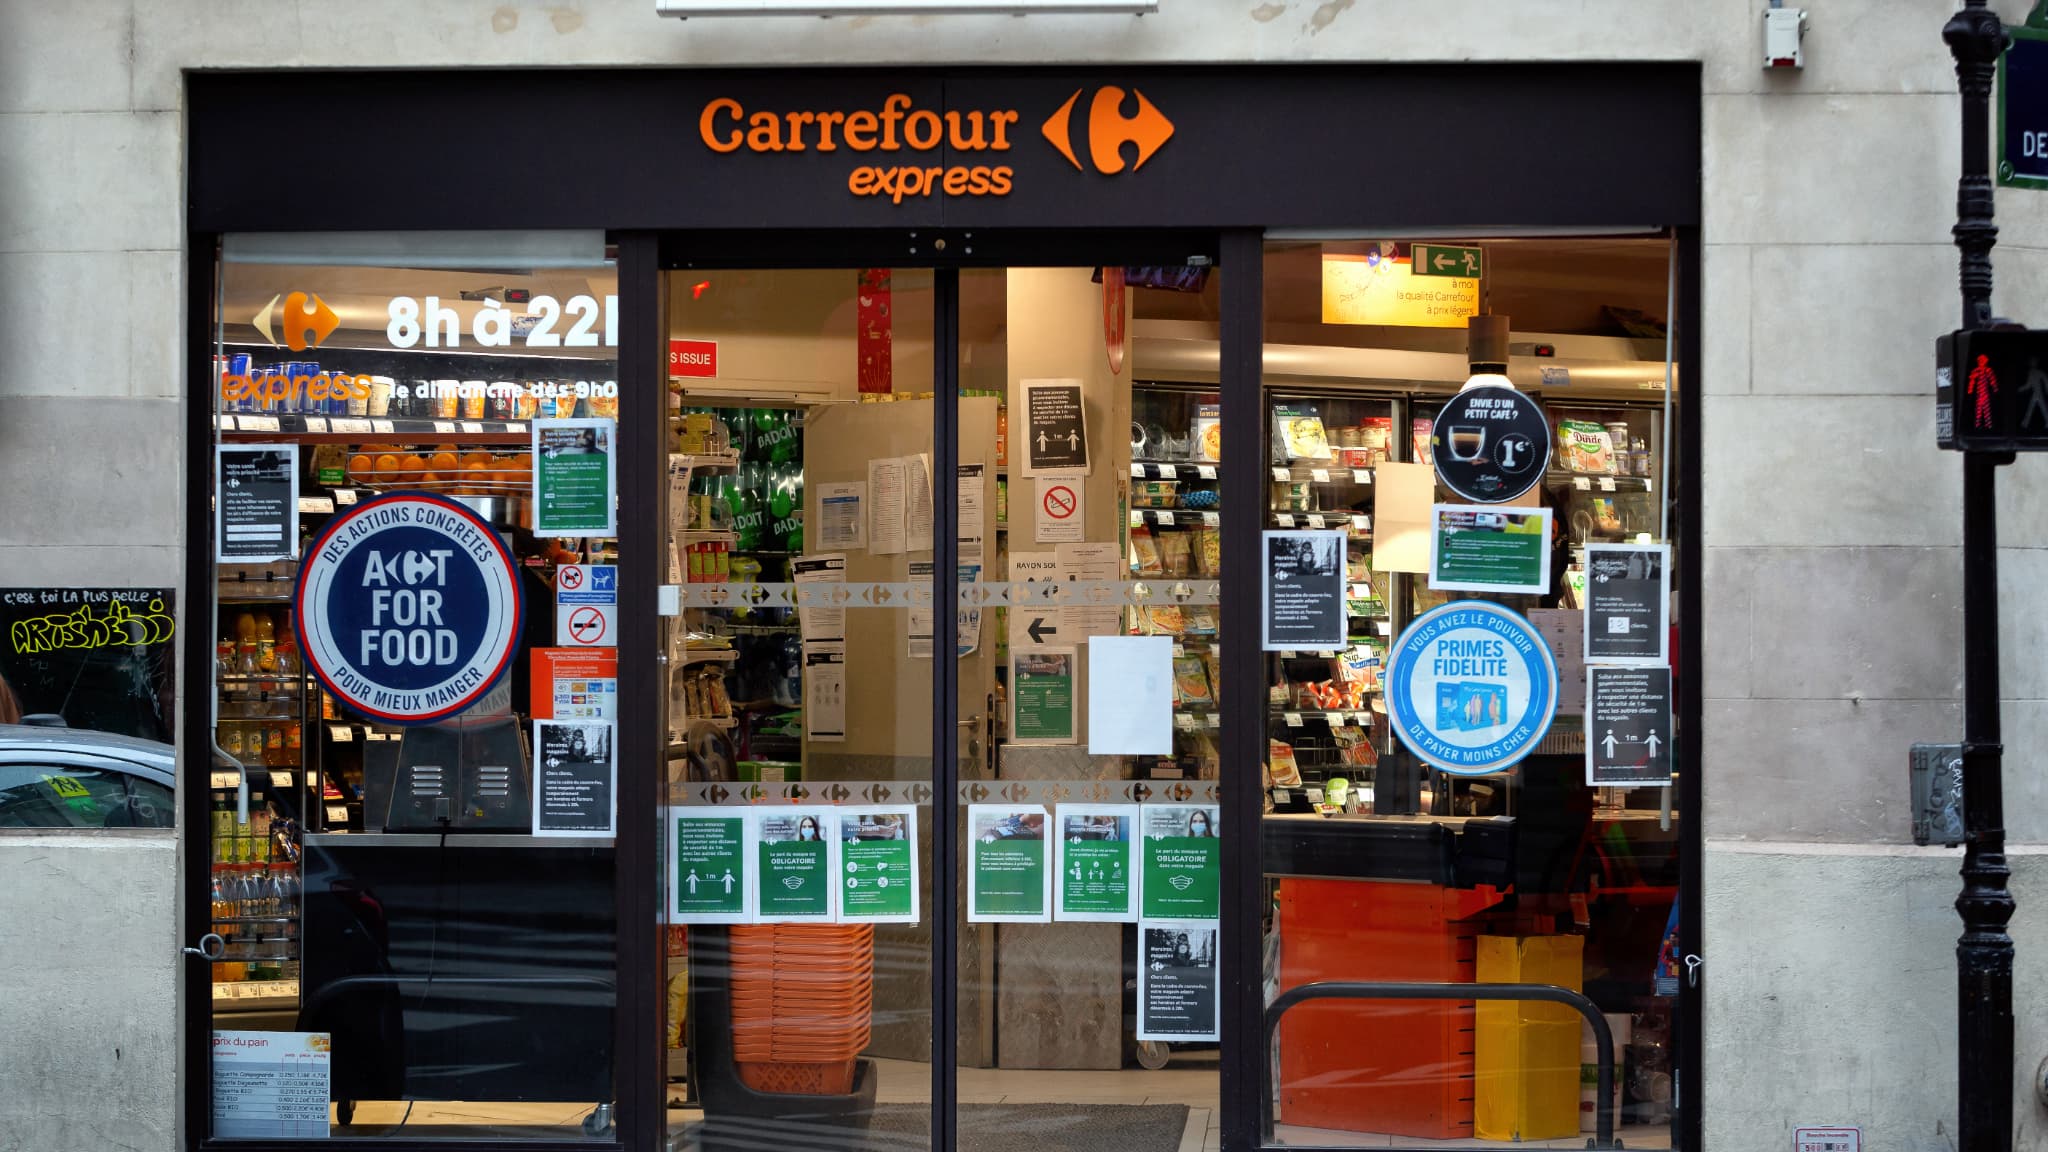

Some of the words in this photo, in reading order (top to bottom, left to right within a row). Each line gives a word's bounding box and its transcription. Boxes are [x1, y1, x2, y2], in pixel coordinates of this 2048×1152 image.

[700, 94, 1018, 153] Carrefour
[848, 165, 1014, 204] express
[1459, 280, 1474, 288] moi
[1405, 291, 1434, 305] qualité
[1435, 291, 1474, 302] Carrefour
[387, 296, 460, 348] 8h
[473, 297, 511, 346] à
[1433, 306, 1449, 317] prix
[1450, 305, 1474, 318] légers
[680, 352, 711, 365] ISSUE
[221, 374, 373, 410] express
[389, 380, 409, 399] le
[415, 379, 522, 399] dimanche
[525, 380, 569, 399] dès
[1464, 409, 1489, 419] PETIT
[1470, 398, 1493, 408] ENVIE
[757, 425, 797, 449] BADOIT
[323, 535, 350, 564] DES
[349, 507, 410, 541] ACTIONS
[415, 507, 493, 563] CONCRÈTES
[361, 549, 454, 587] ACT
[40, 590, 59, 603] toi
[63, 590, 79, 603] LA
[372, 589, 444, 626] FOR
[1407, 625, 1436, 653] VOUS
[1438, 613, 1467, 631] AVEZ
[1471, 614, 1484, 625] LE
[1487, 616, 1533, 654] POUVOIR
[360, 628, 459, 666] FOOD
[1437, 640, 1504, 658] PRIMES
[1433, 658, 1508, 677] FIDÉLITÉ
[332, 666, 372, 701] POUR
[374, 690, 422, 711] MIEUX
[425, 666, 484, 704] MANGER
[1410, 724, 1424, 740] DE
[1423, 737, 1459, 761] PAYER
[1463, 746, 1501, 762] MOINS
[1502, 725, 1531, 752] CHER
[1156, 855, 1207, 863] OBLIGATOIRE
[213, 1037, 231, 1047] prix
[234, 1036, 246, 1046] du
[247, 1038, 269, 1048] pain
